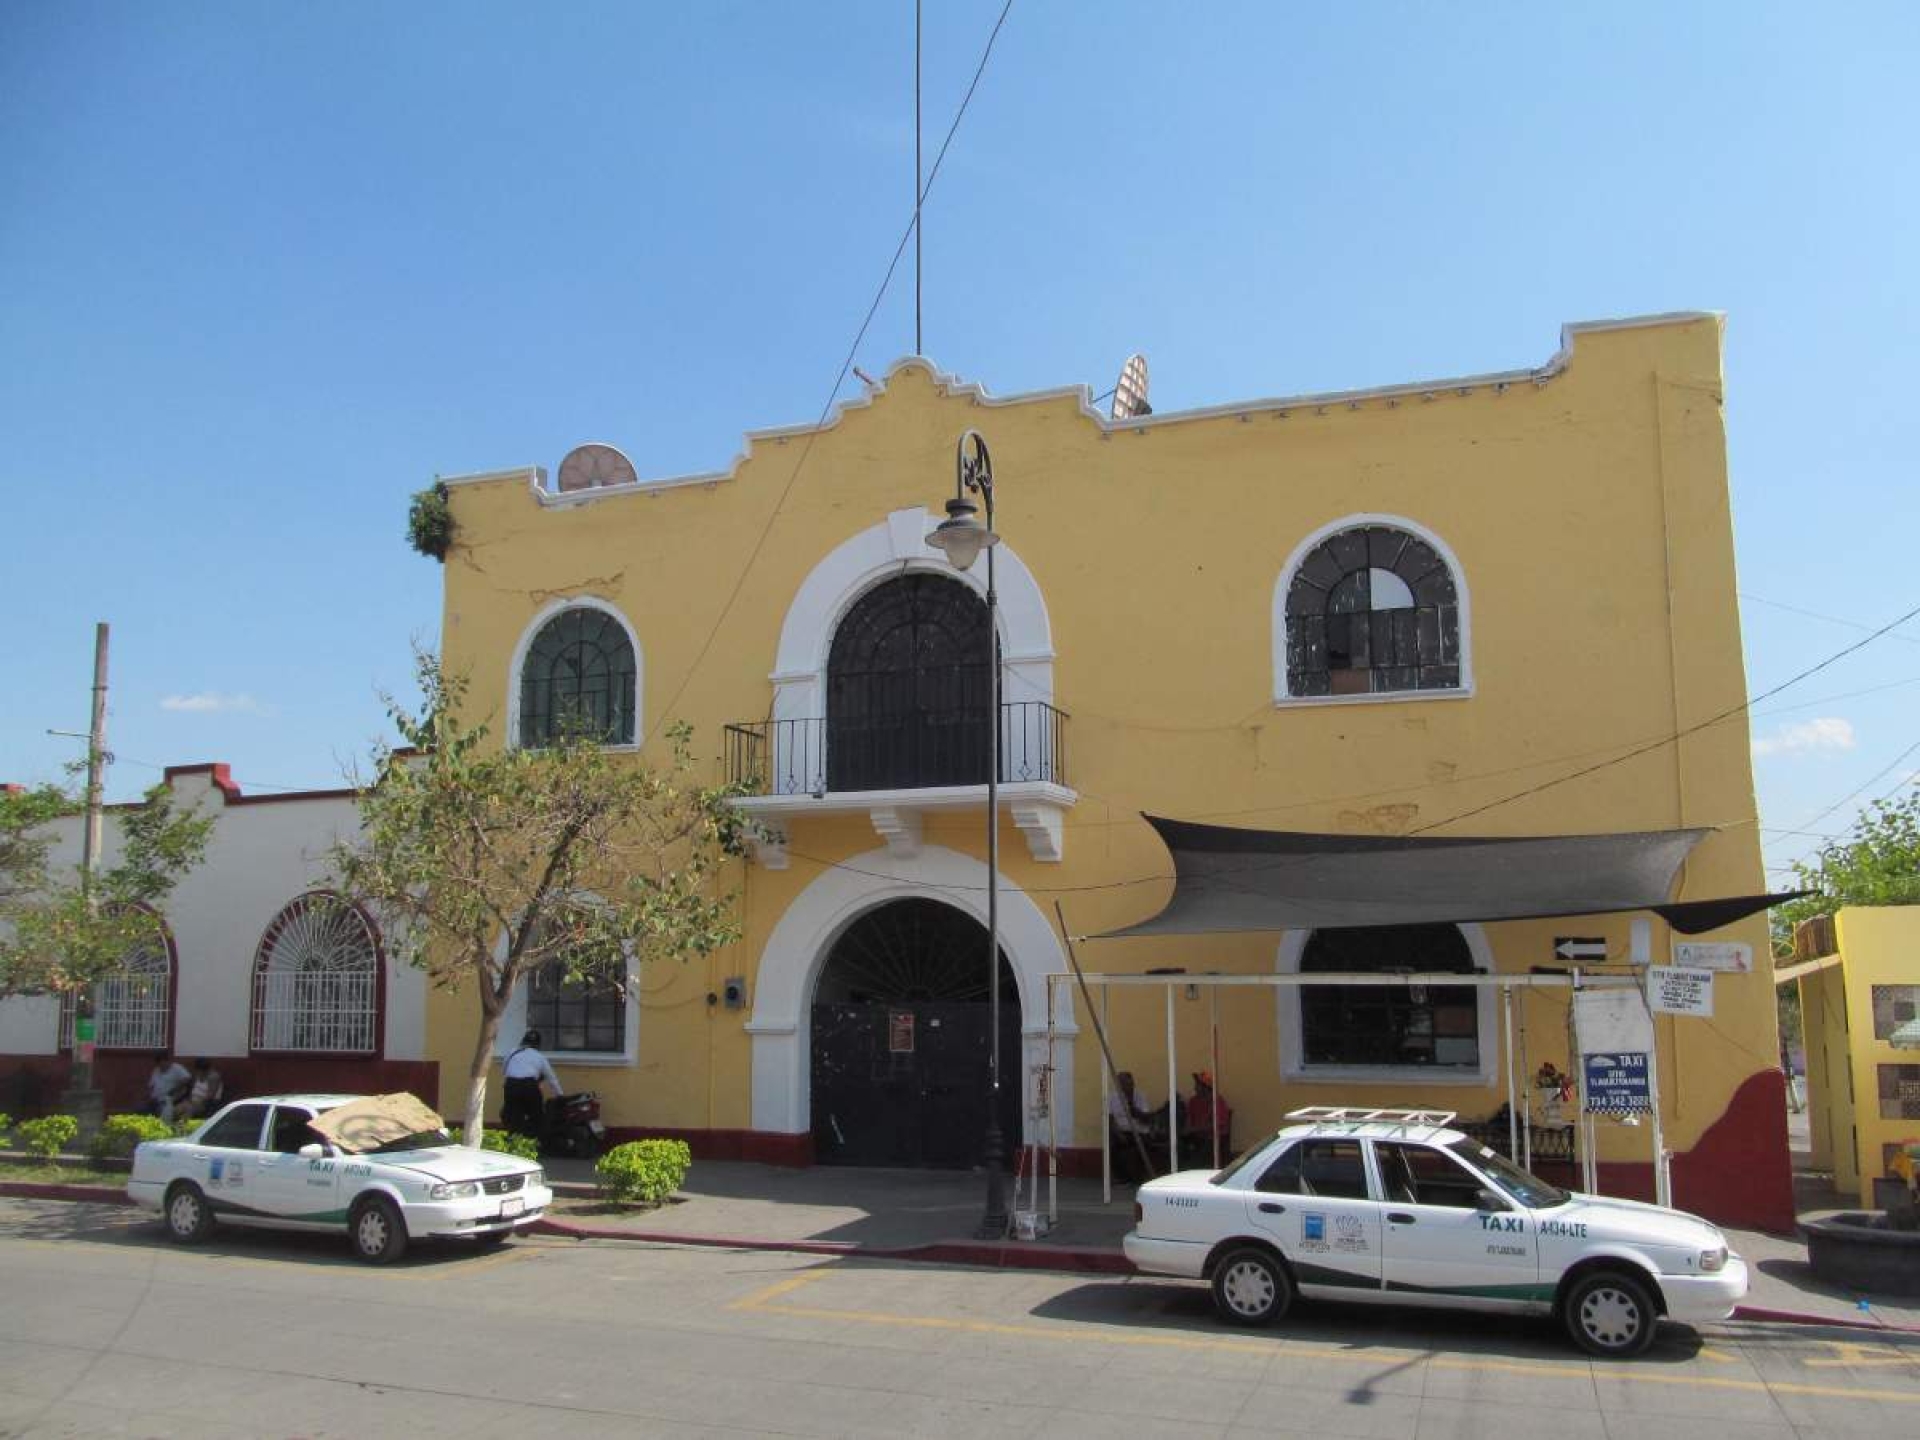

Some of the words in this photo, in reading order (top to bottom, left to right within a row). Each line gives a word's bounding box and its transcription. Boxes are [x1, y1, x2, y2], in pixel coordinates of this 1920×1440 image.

[1618, 1055, 1643, 1067] TAXI
[309, 1159, 335, 1173] TAXI
[1479, 1215, 1524, 1233] TAXI
